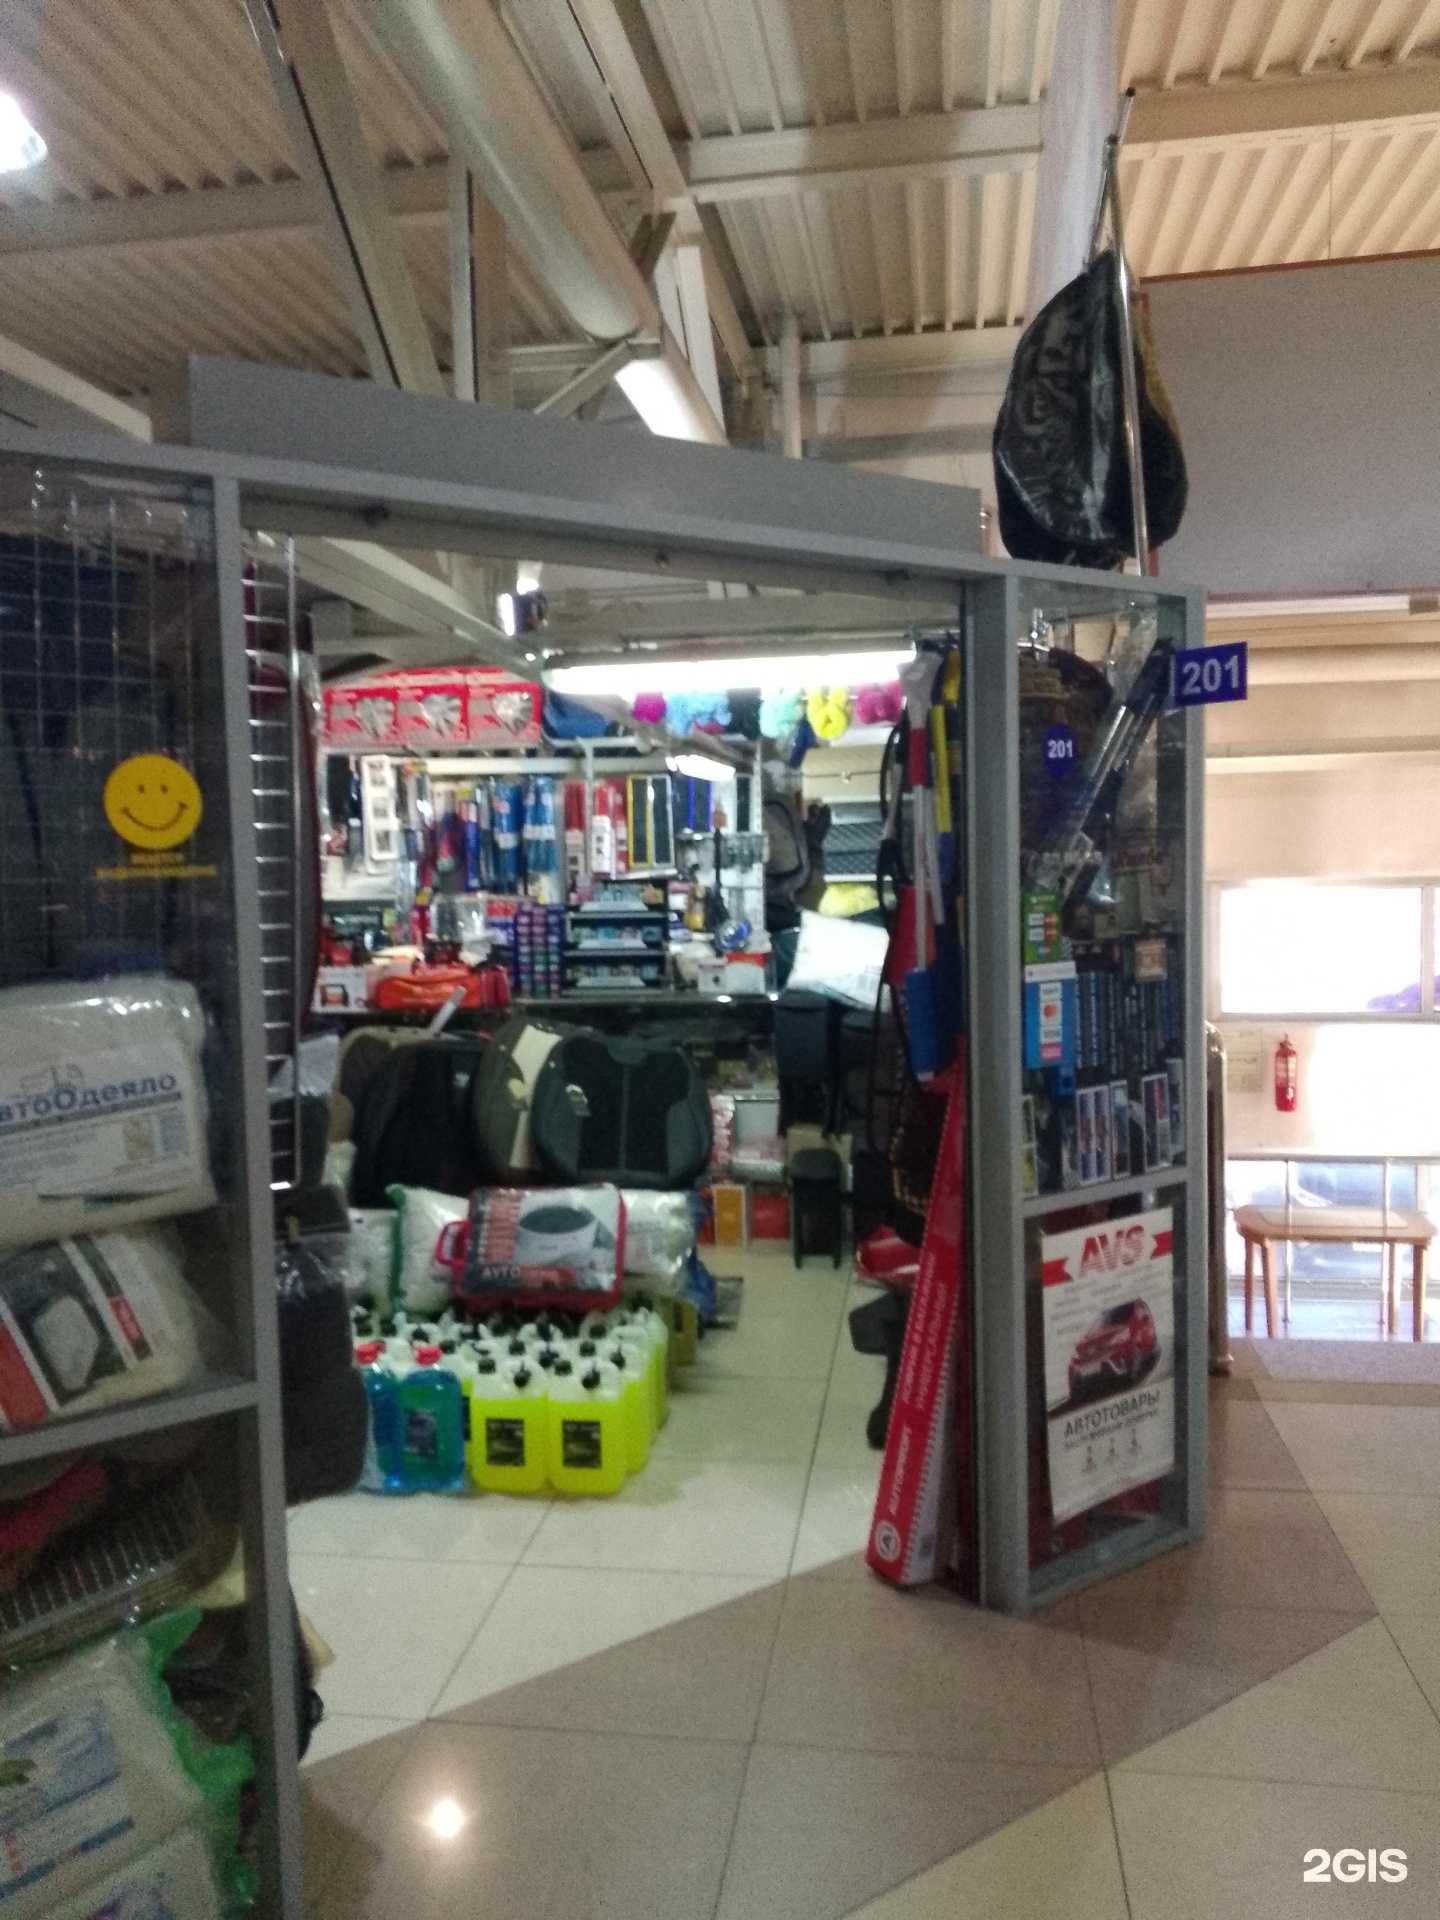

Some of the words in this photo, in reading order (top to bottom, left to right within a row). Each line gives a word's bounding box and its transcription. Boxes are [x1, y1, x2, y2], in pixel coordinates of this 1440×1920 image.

[1182, 656, 1240, 696] 201
[1047, 739, 1074, 759] 201
[1079, 1225, 1145, 1276] AVS
[1064, 1389, 1160, 1439] АВТОТОВАРЫ
